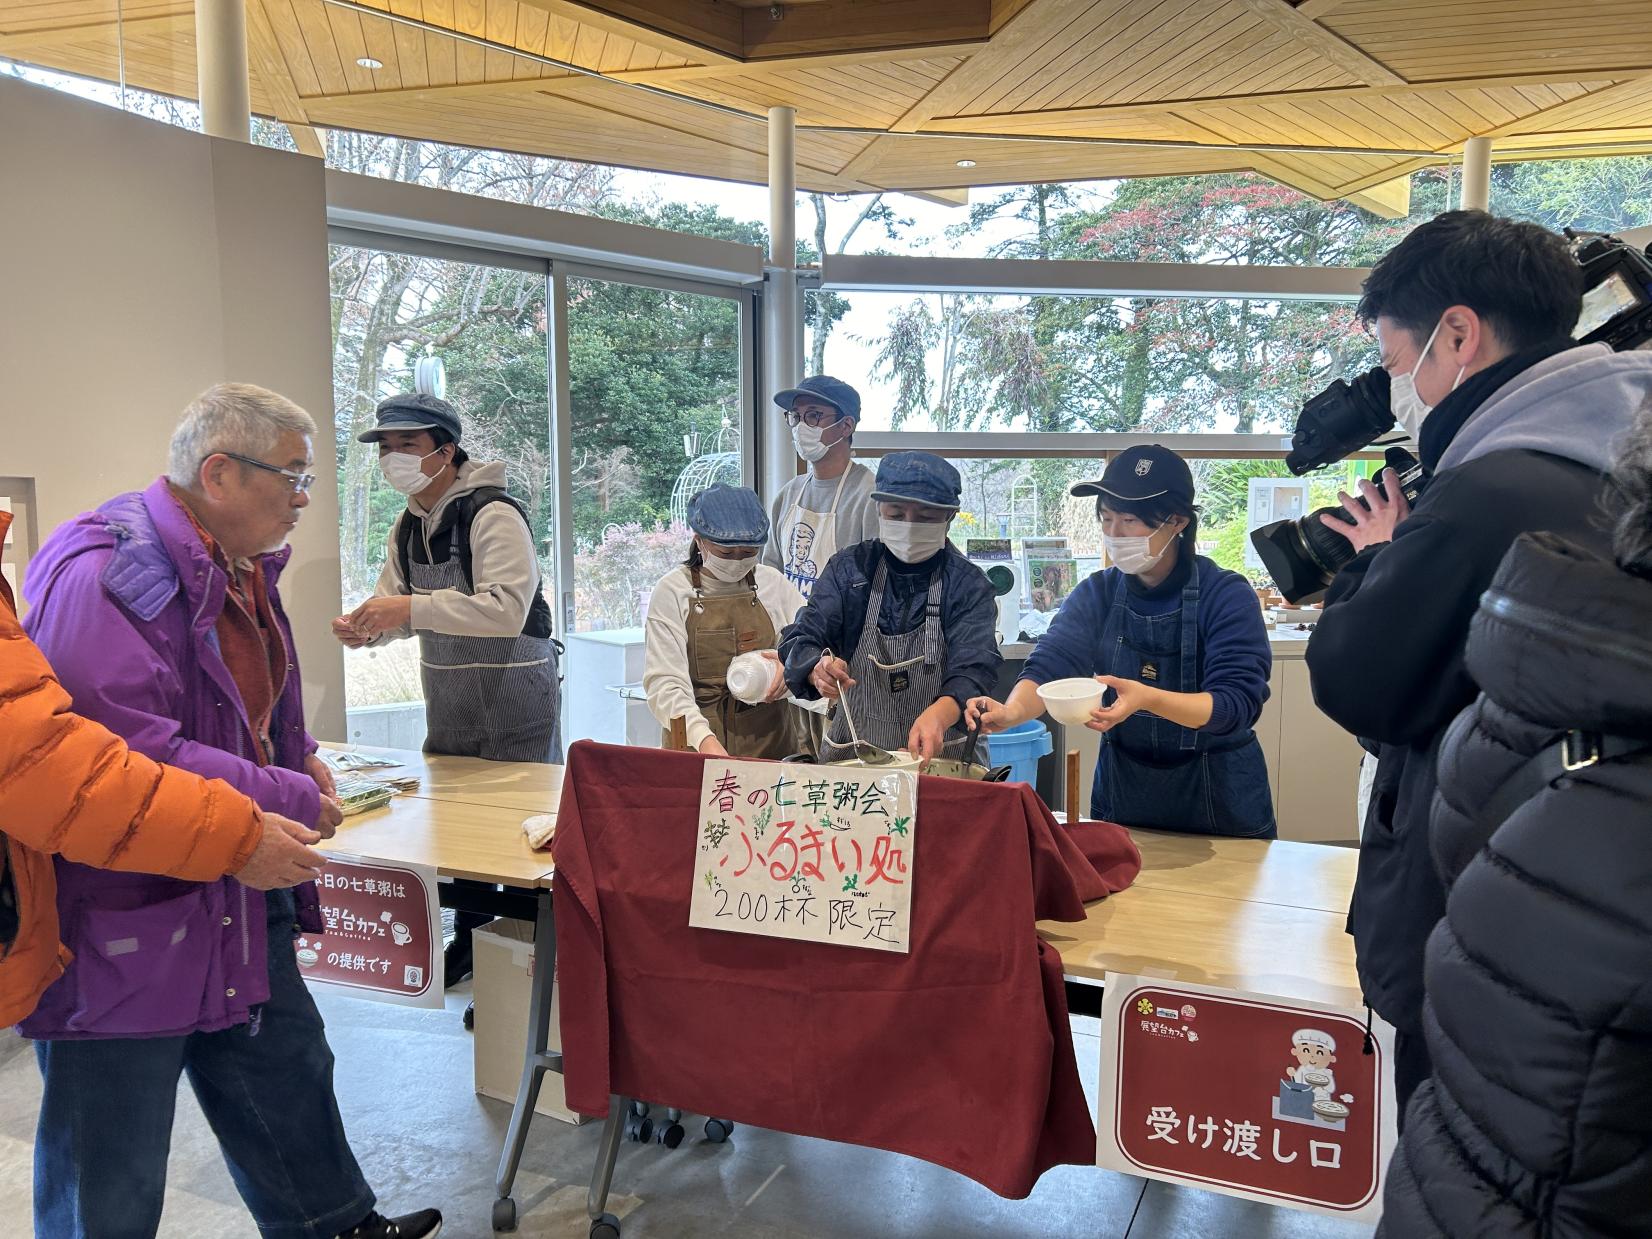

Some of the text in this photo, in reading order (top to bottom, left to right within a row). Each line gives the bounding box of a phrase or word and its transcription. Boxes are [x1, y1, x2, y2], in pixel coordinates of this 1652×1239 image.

[708, 768, 890, 816] 春の七草粥会
[719, 815, 907, 885] ふるまい処
[319, 905, 386, 937] 望台カフェ
[714, 889, 900, 944] 200杯限定
[327, 952, 392, 974] の提供です
[1145, 1106, 1342, 1169] 受け渡し口
